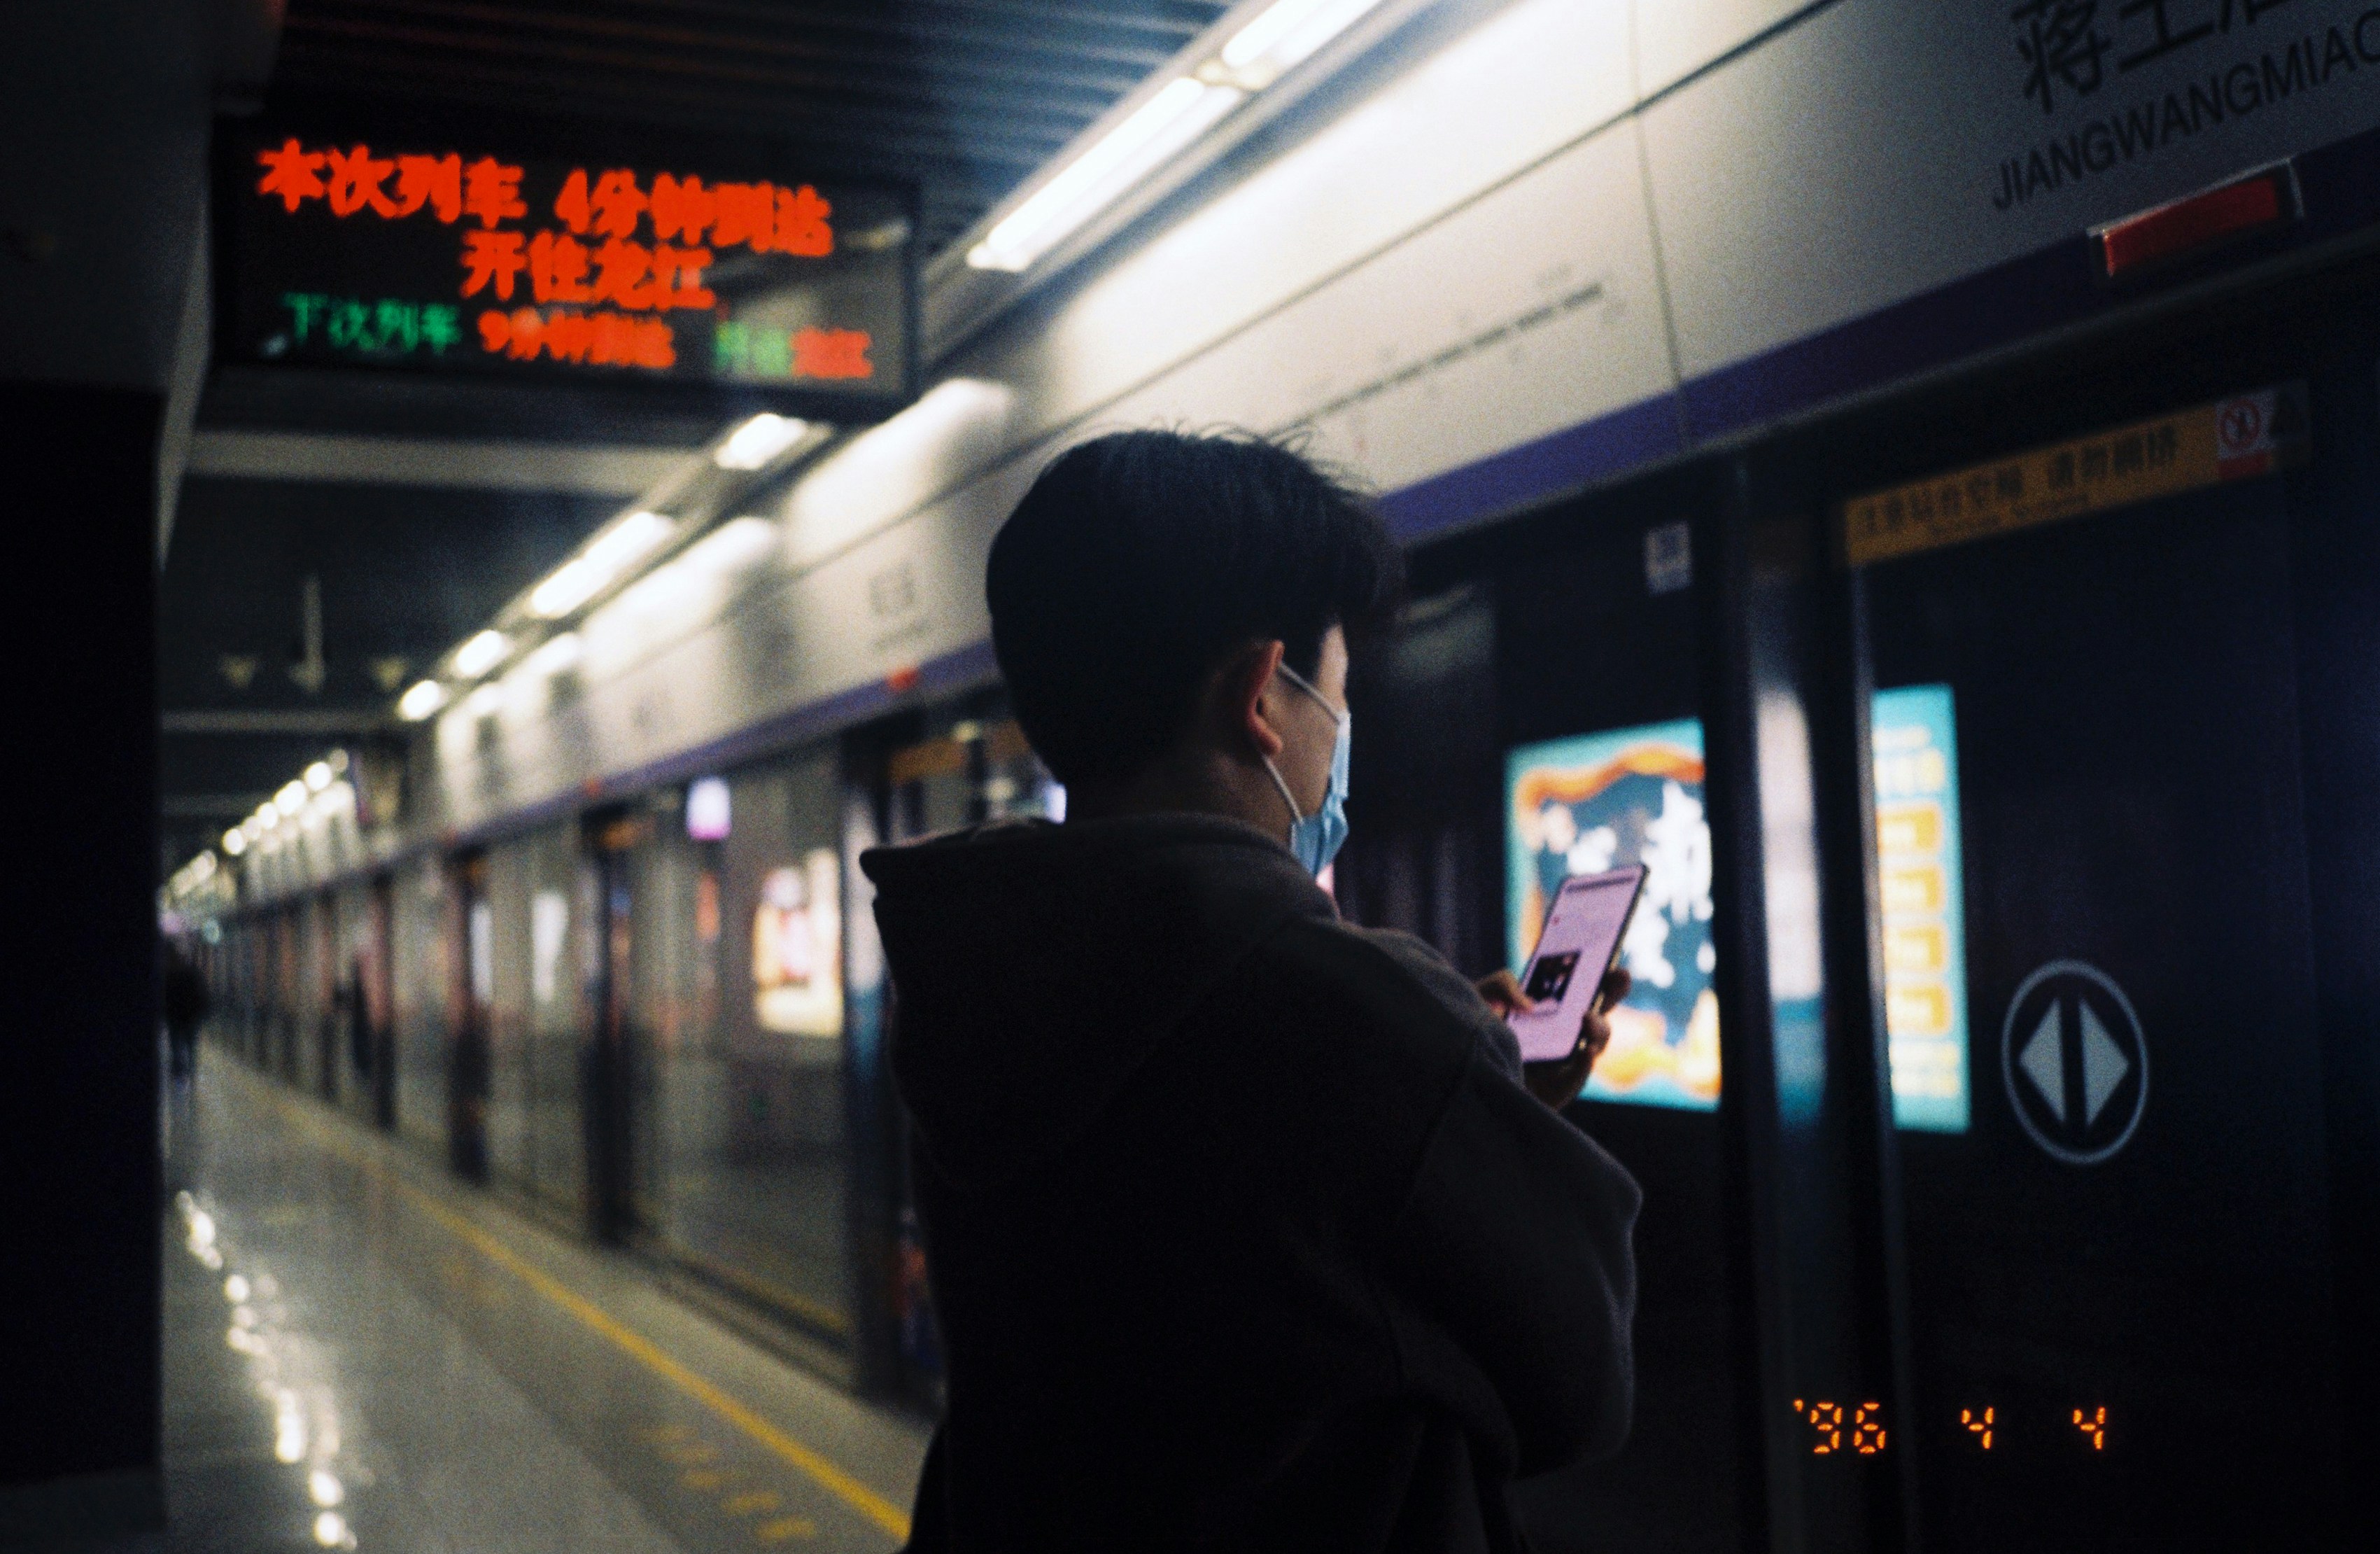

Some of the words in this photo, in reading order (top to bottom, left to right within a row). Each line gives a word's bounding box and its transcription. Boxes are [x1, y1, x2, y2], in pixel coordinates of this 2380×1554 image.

[1993, 9, 2380, 210] JIANGWANGMIAO
[2011, 0, 2287, 113] 蒋王
[258, 139, 527, 228] 本次列车
